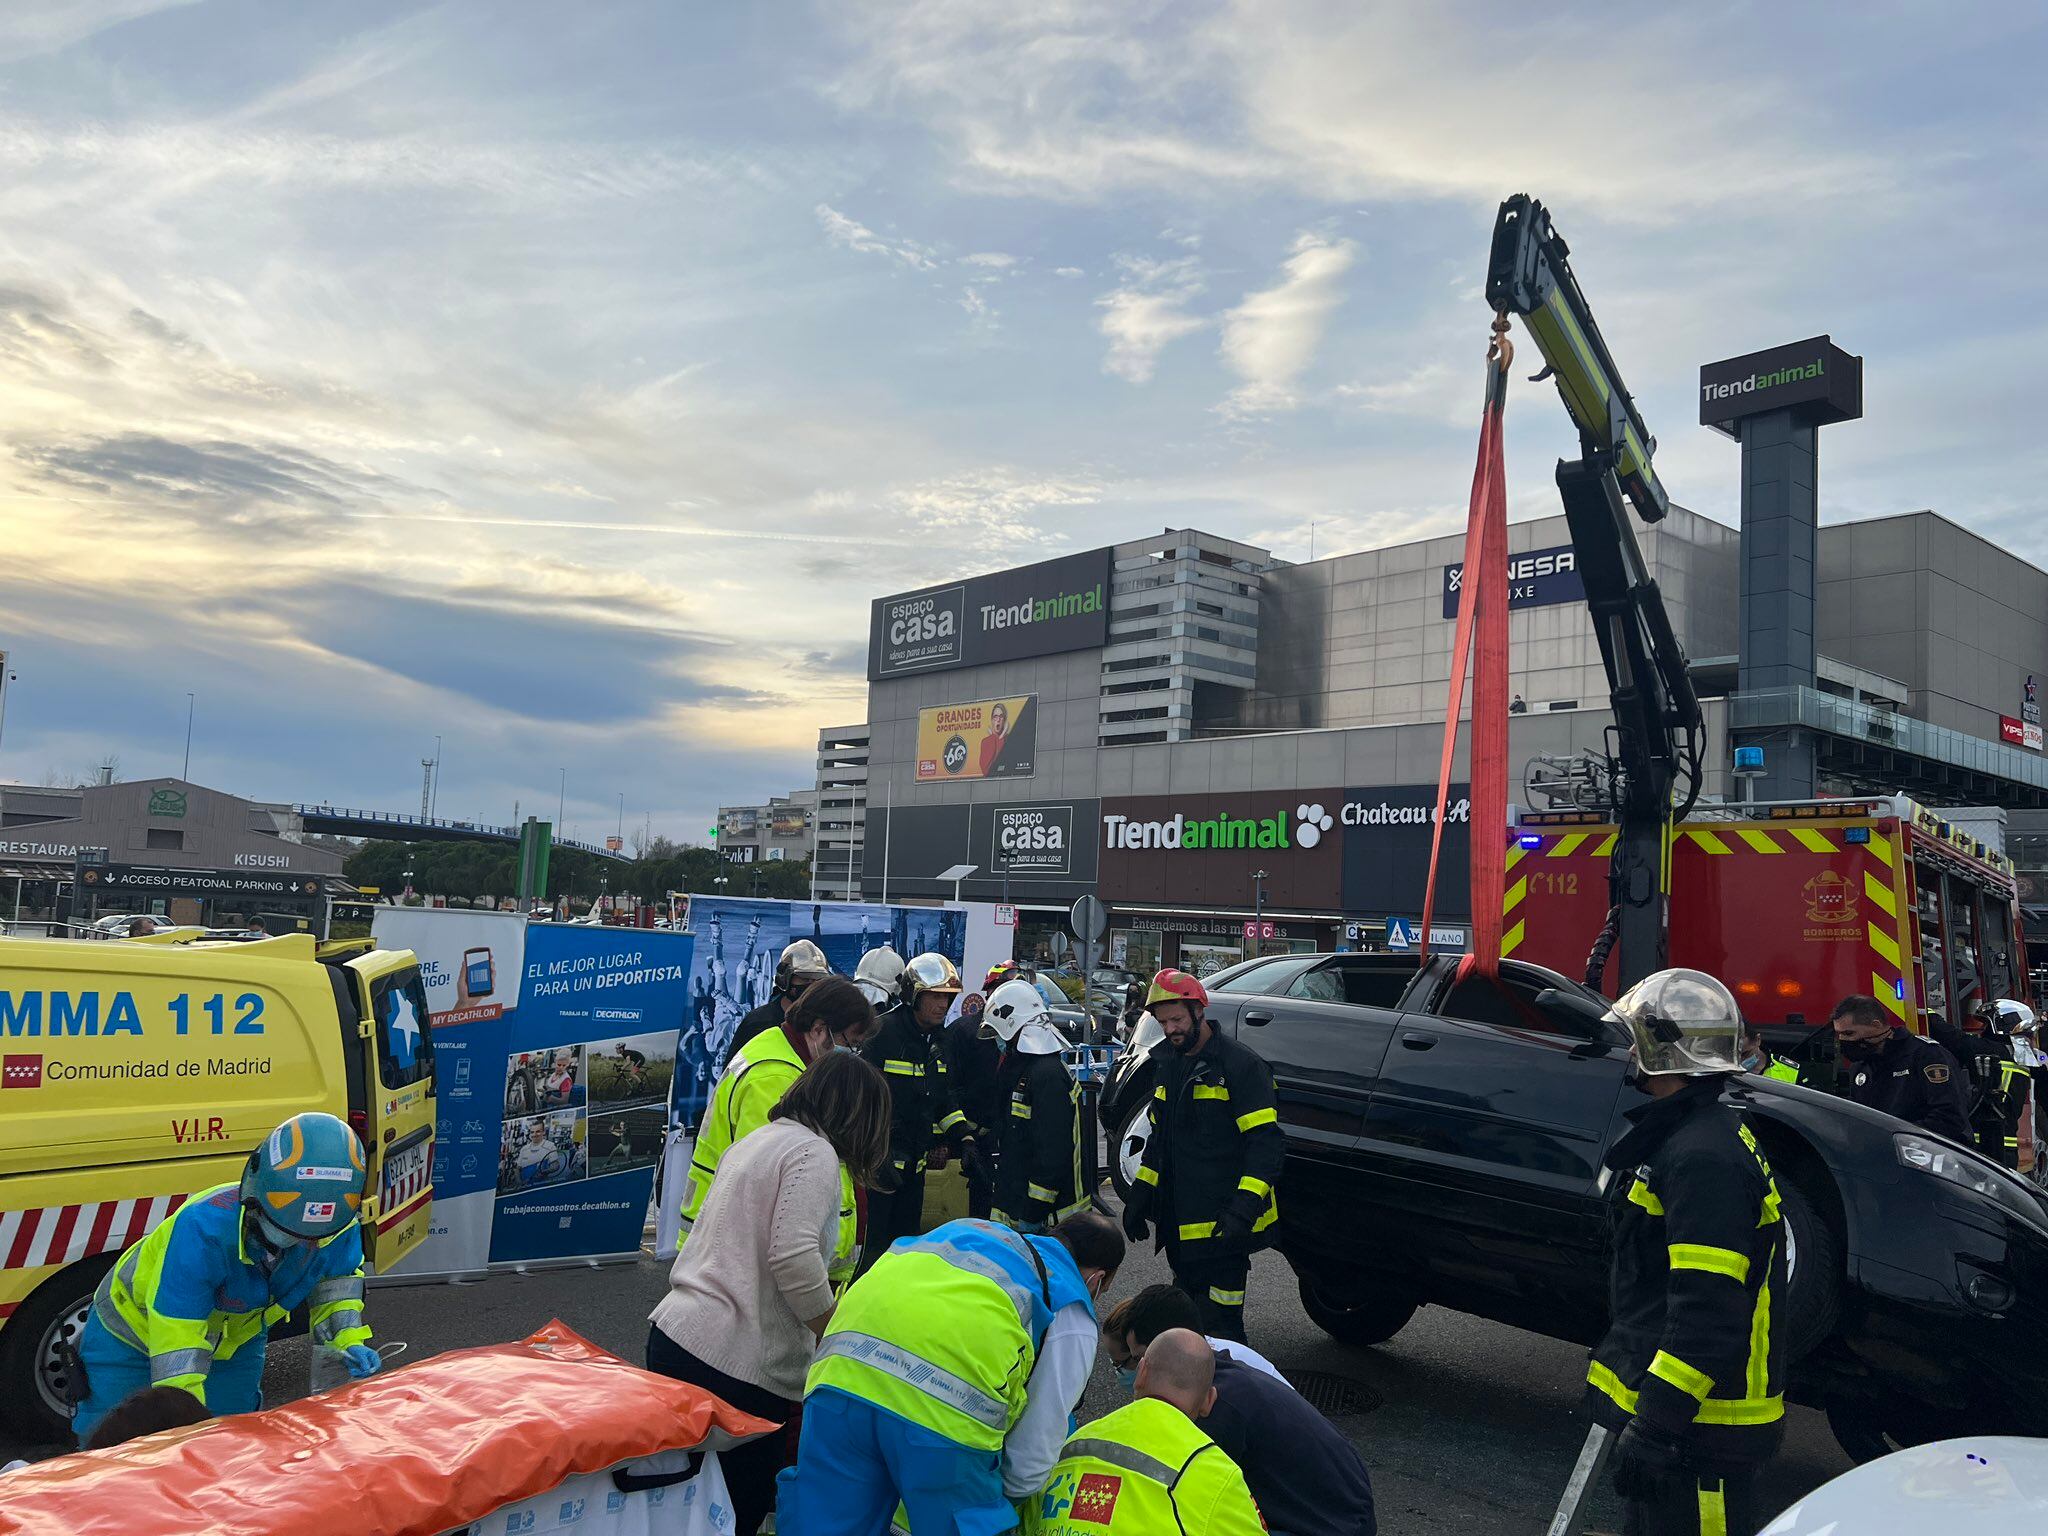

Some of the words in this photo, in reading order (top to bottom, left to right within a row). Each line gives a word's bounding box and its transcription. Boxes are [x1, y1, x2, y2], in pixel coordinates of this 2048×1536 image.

[1702, 358, 1825, 401] Tiendanimal
[891, 599, 934, 619] espaço
[980, 583, 1103, 631] Tiendanimal
[890, 610, 954, 646] casa
[906, 648, 921, 660] para
[921, 647, 926, 655] a
[927, 645, 938, 655] sua
[938, 643, 953, 652] casa
[937, 708, 982, 724] GRANDES
[936, 721, 981, 733] OPORTUNIDADES
[2003, 723, 2023, 737] VIPS
[1002, 812, 1043, 829] espaço
[1340, 802, 1428, 826] Chateau
[1001, 825, 1063, 850] casa
[1103, 810, 1289, 849] Tiendanimal
[0, 841, 108, 857] RESTAURA
[234, 854, 290, 868] KISUSHI
[1017, 855, 1031, 865] para
[1031, 855, 1036, 863] a
[1037, 855, 1047, 863] sua
[1047, 855, 1062, 863] casa
[120, 874, 170, 886] ACCESO
[173, 878, 233, 890] PEATONAL
[235, 881, 284, 892] PARKING
[1546, 872, 1578, 895] 112
[1132, 917, 1198, 933] Entendemos
[1200, 924, 1208, 933] a
[1210, 920, 1227, 934] las
[1803, 928, 1862, 936] BOMBEROS
[1429, 934, 1463, 943] ILANO
[528, 964, 544, 978] EL
[548, 957, 595, 976] MEJOR
[598, 952, 642, 969] LUGAR
[533, 983, 570, 997] PARA
[573, 977, 593, 991] UN
[595, 965, 683, 989] DEPORTISTA
[167, 993, 265, 1035] 112
[432, 1015, 446, 1025] MY
[447, 1008, 496, 1023] DECATHLON
[595, 1010, 640, 1020] DECATHLON
[47, 1060, 169, 1080] Comunidad
[176, 1059, 201, 1077] de
[207, 1057, 271, 1076] Madrid
[171, 1116, 231, 1144] V.I.R.
[390, 1154, 407, 1180] 6221
[410, 1145, 424, 1168] JHL
[503, 1201, 631, 1215] trabajaconnosotros.decathlon.es
[428, 1226, 448, 1236] n.es
[874, 1350, 899, 1366] SUMMA
[900, 1361, 912, 1372] 112
[930, 1376, 954, 1392] SUMMA
[955, 1389, 967, 1400] 112
